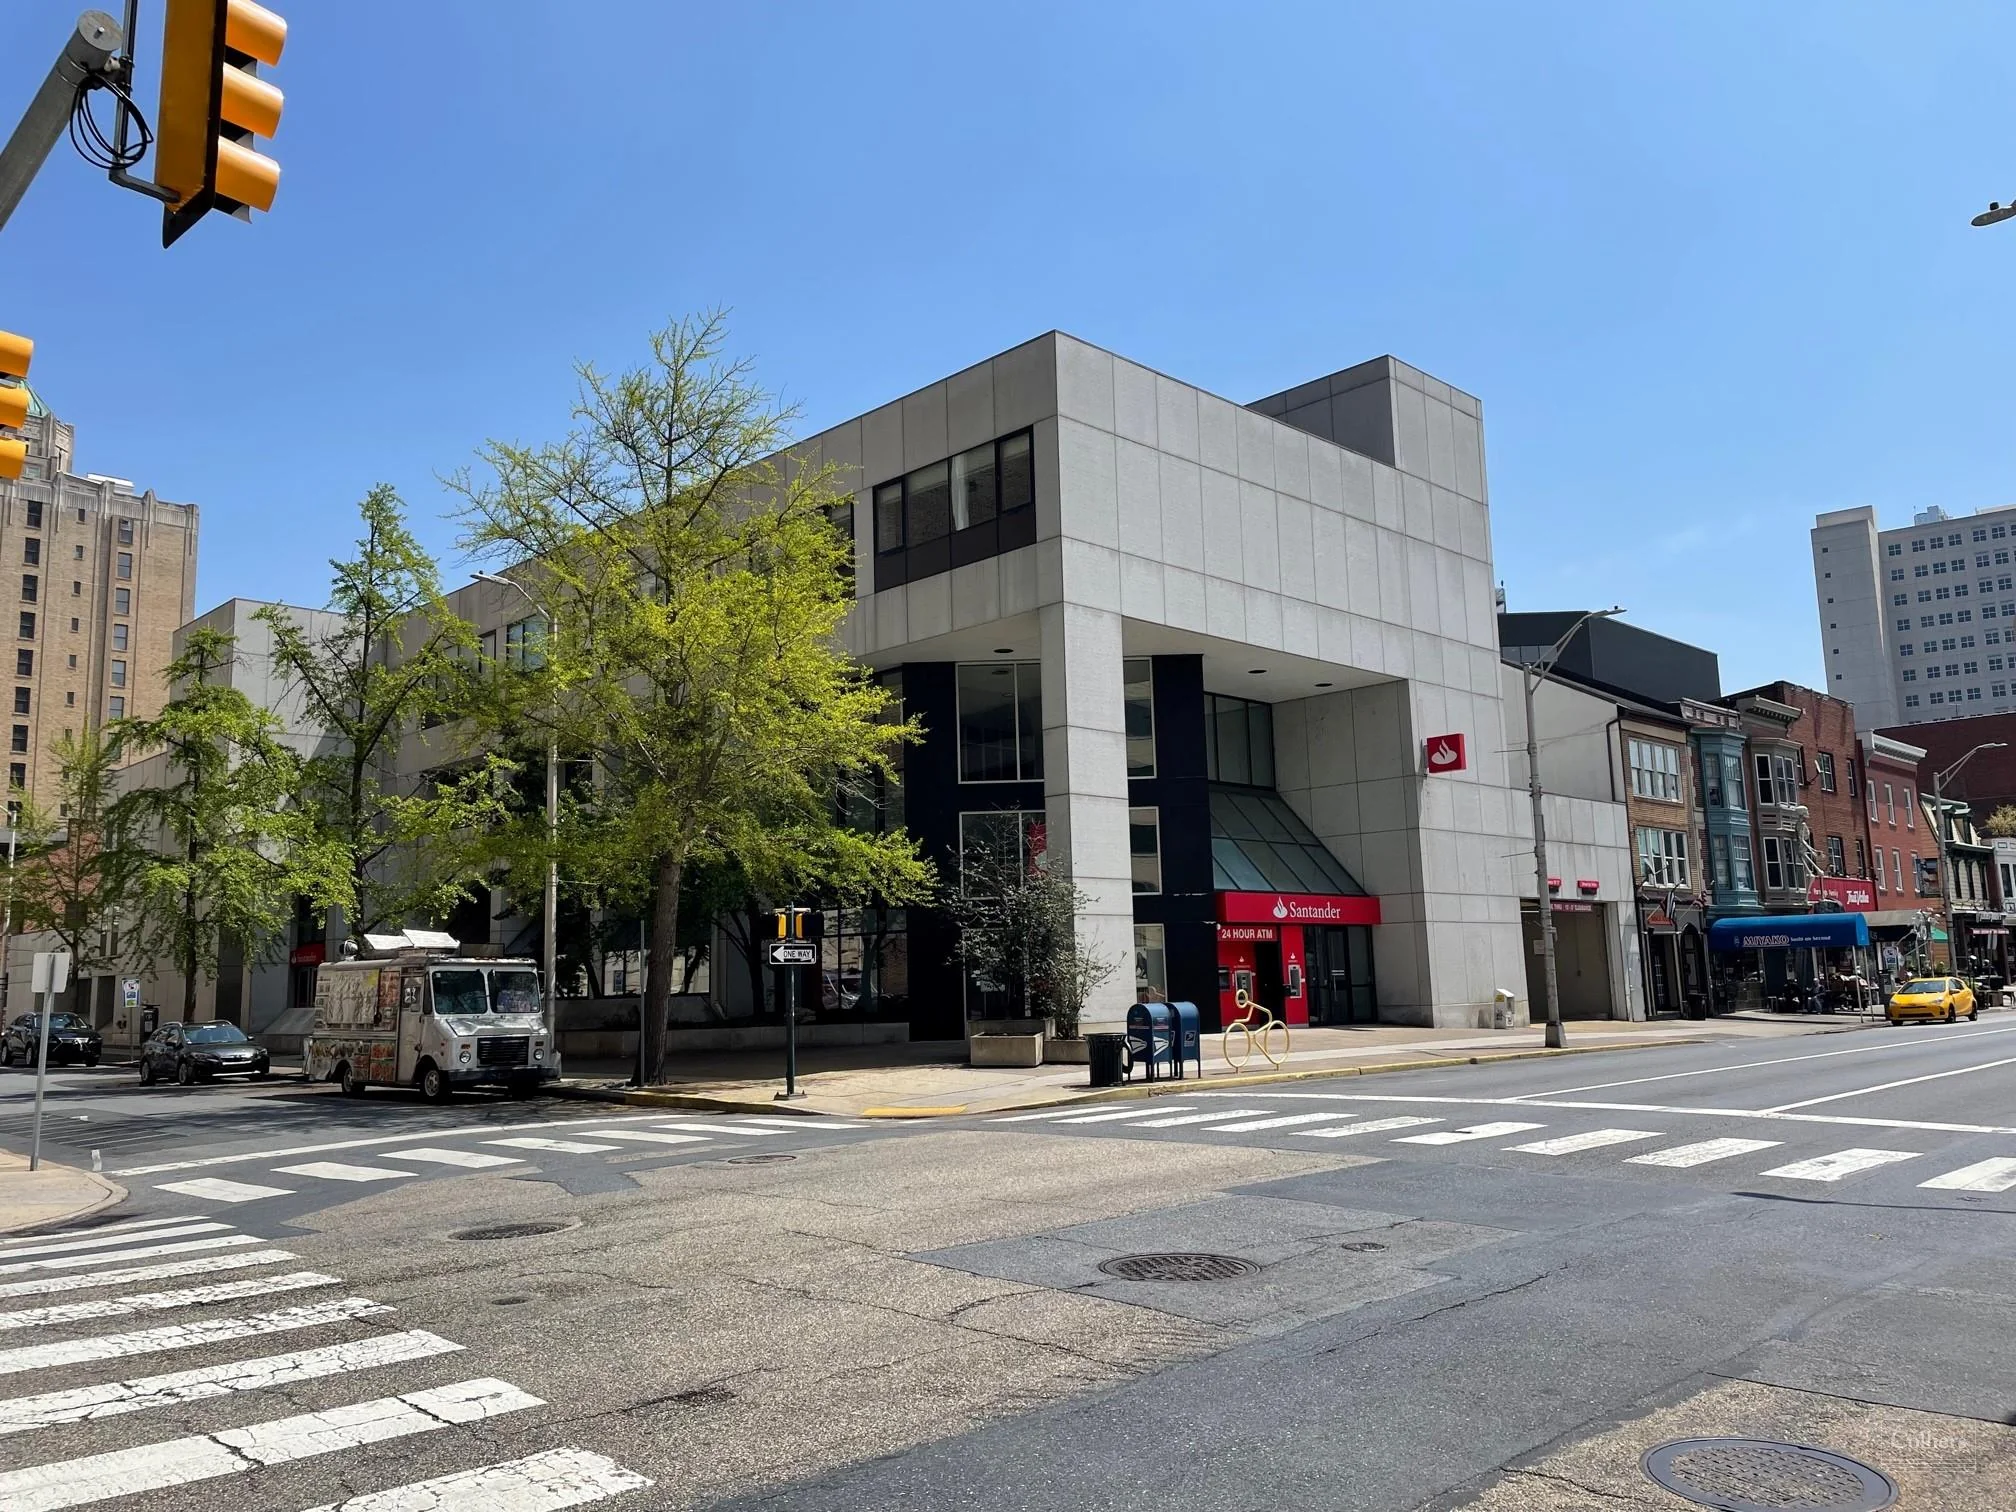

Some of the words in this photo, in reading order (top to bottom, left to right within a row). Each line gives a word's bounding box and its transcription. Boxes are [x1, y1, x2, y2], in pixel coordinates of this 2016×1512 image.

[1289, 901, 1341, 919] Santander
[1221, 928, 1231, 938] 24
[1232, 928, 1256, 939] HOUR
[1256, 929, 1273, 939] ATM
[1743, 935, 1790, 946] MIYAKO
[783, 950, 796, 958] ONE
[797, 950, 811, 958] WAY
